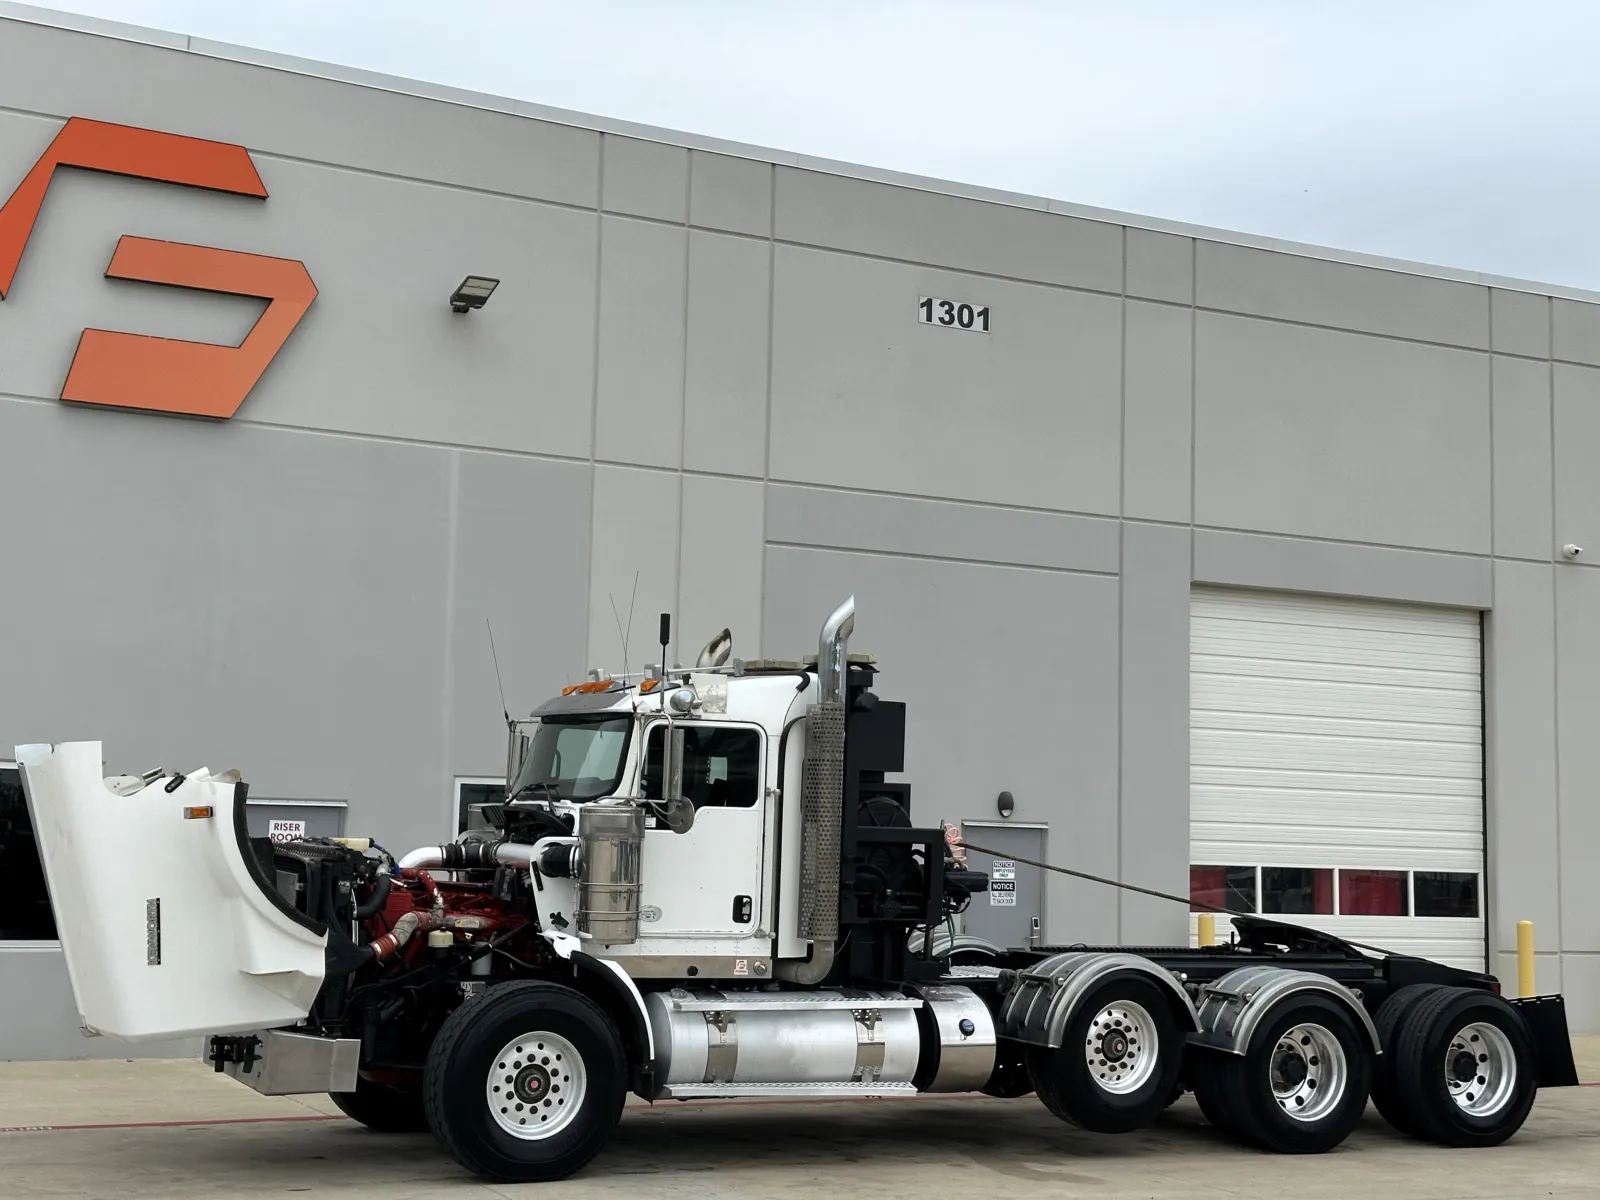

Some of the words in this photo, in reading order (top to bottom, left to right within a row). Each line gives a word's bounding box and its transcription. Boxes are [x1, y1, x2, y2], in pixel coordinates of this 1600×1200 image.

[920, 298, 990, 331] 1301
[274, 822, 300, 831] RISER
[147, 898, 158, 966] KENWORTH
